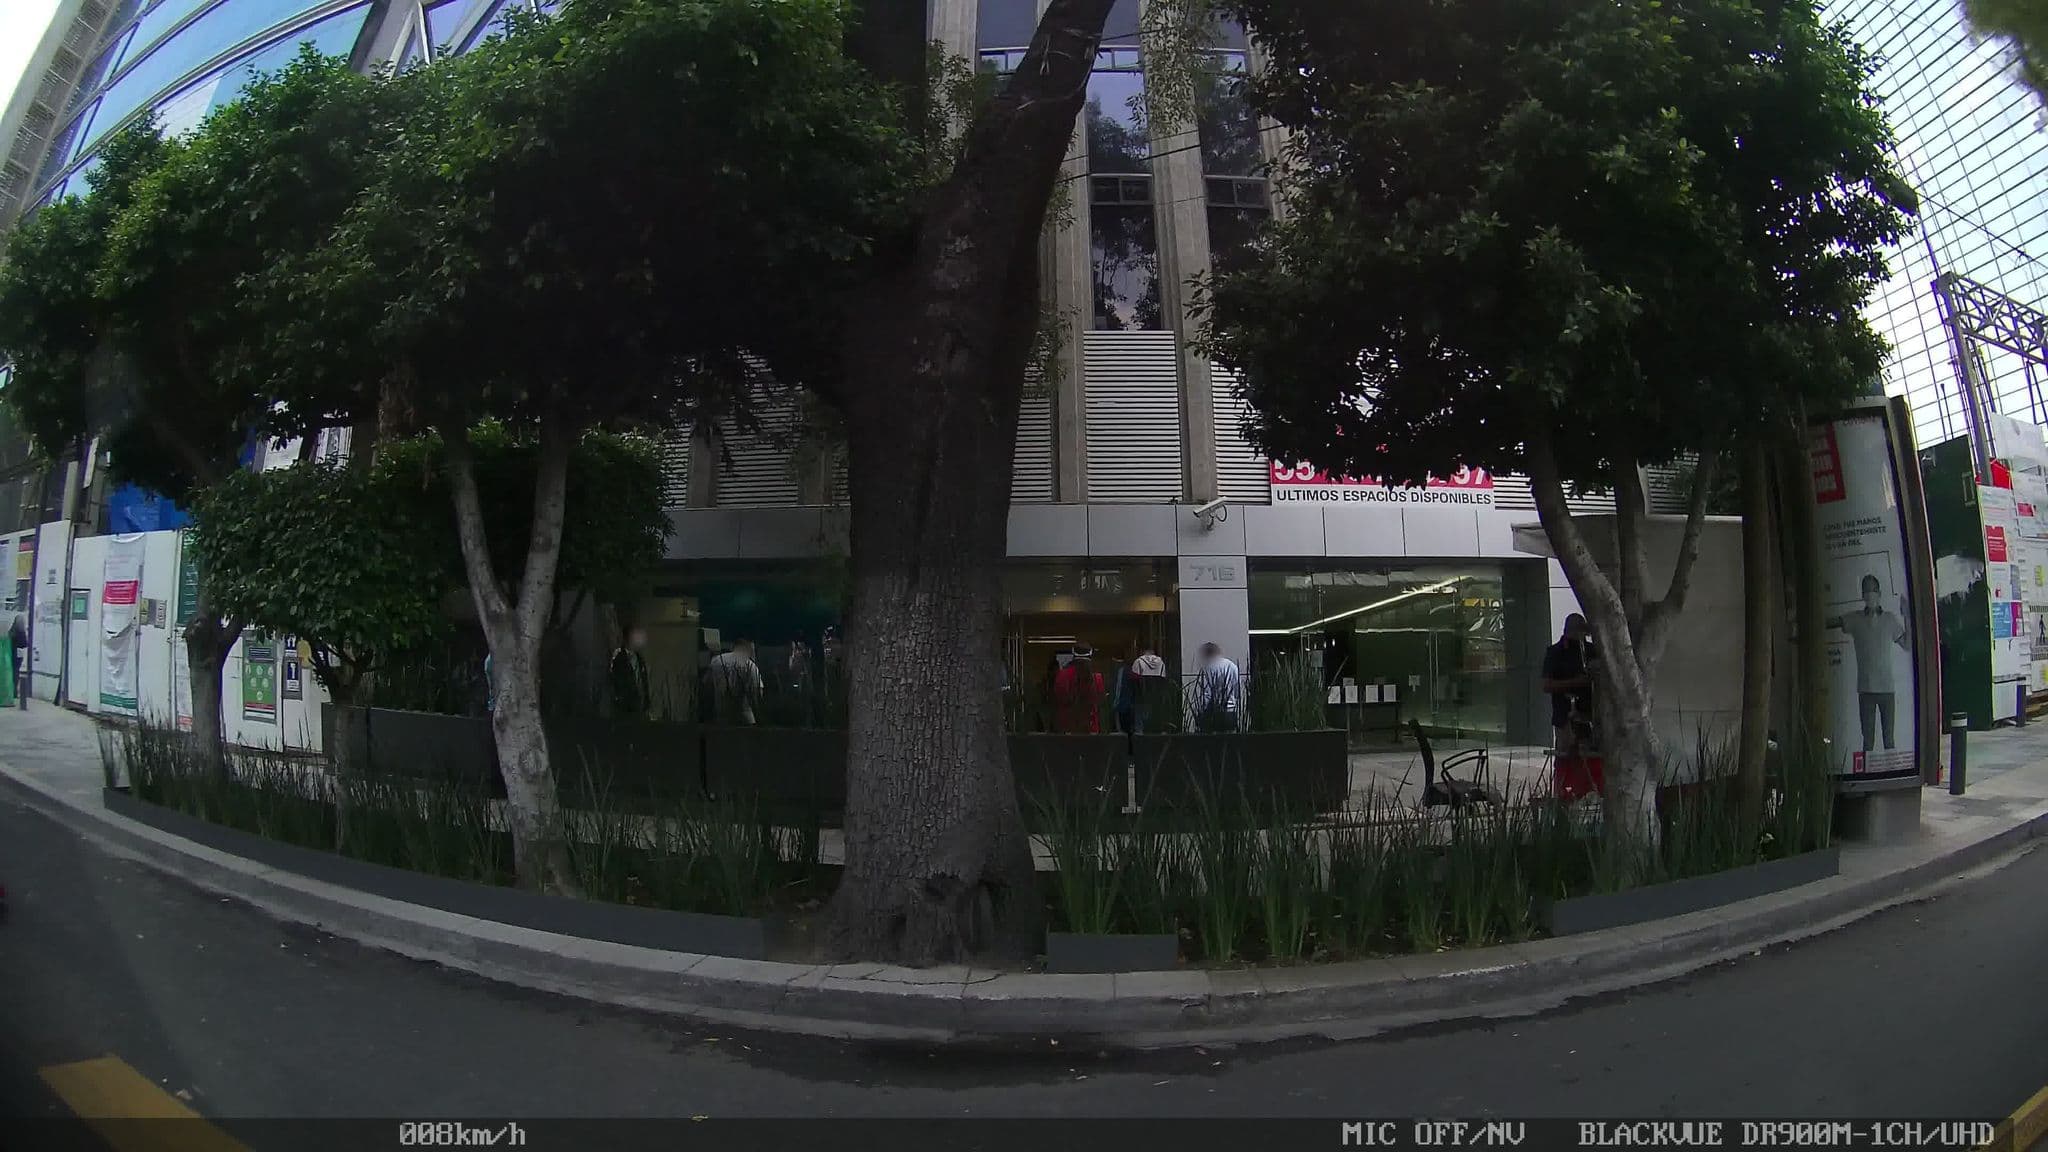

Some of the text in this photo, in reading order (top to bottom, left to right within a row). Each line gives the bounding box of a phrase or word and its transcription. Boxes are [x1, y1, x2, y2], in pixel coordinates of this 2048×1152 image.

[1277, 489, 1491, 505] ULTIMOS ESPACIOS DISPONIBLES
